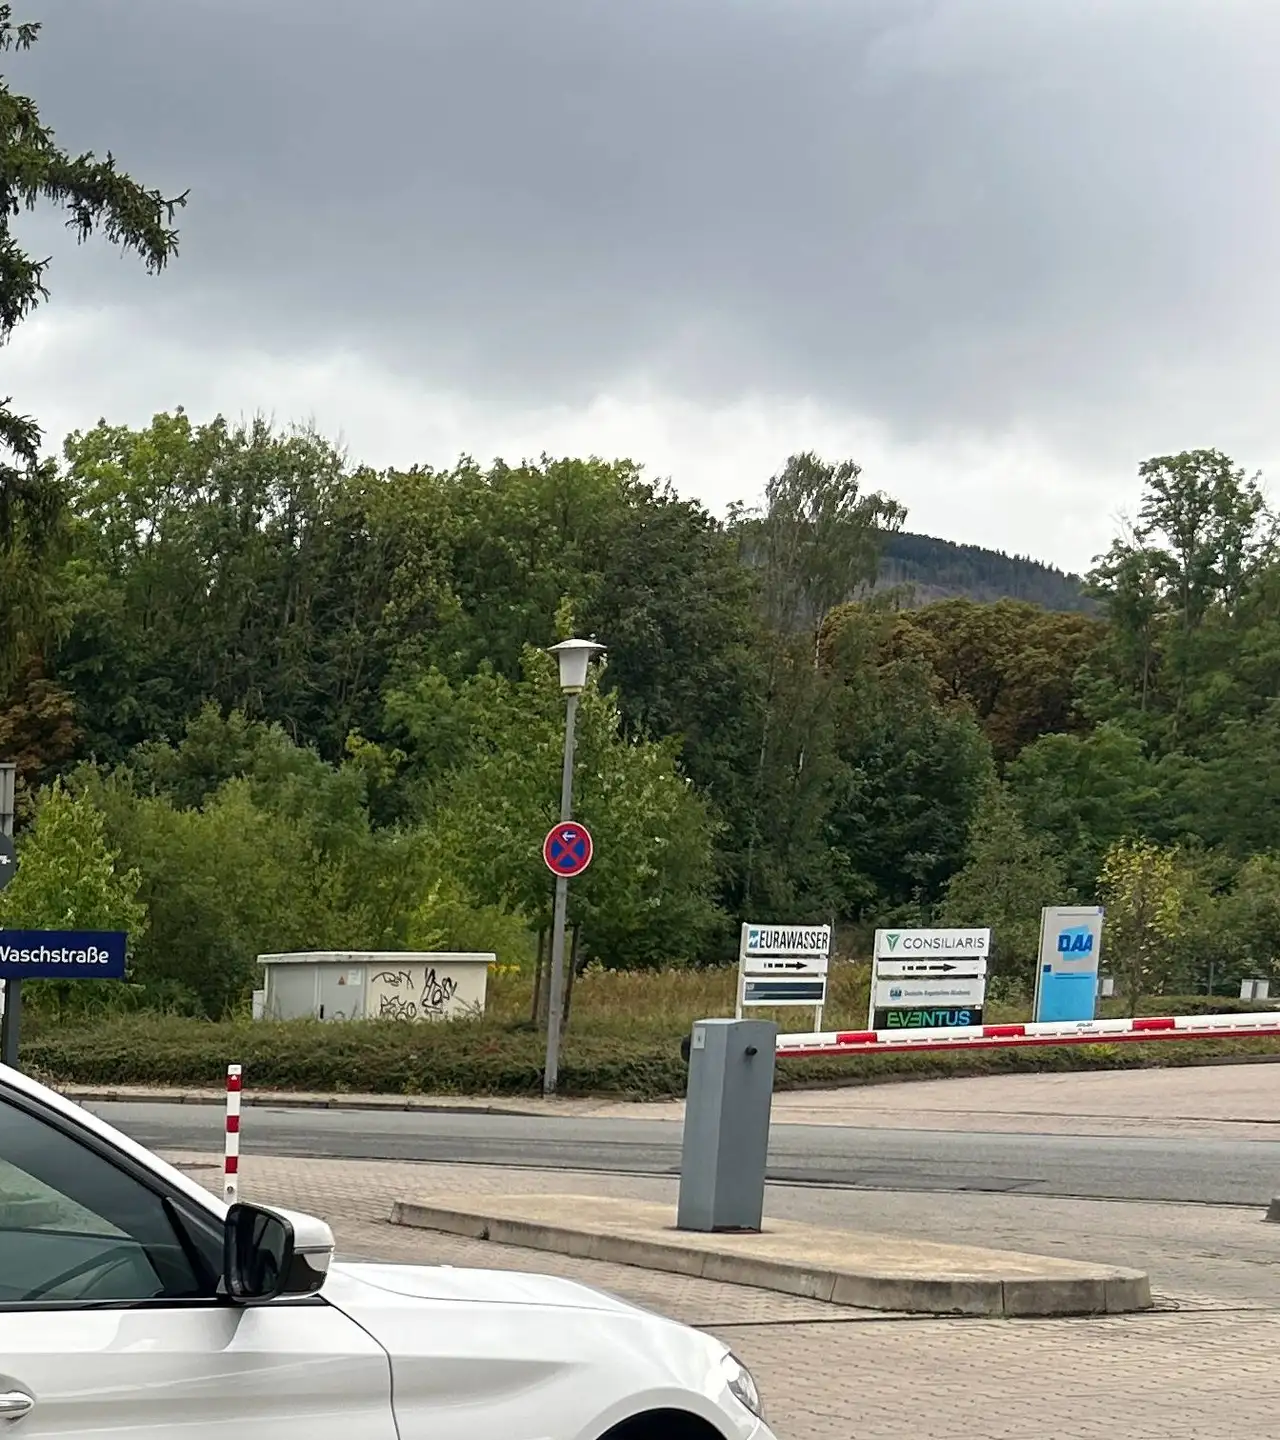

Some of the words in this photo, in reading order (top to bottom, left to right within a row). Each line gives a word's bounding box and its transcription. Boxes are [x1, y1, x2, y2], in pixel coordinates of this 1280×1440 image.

[759, 930, 829, 949] EURAWASSER
[903, 937, 985, 949] CONSILIARIS
[1057, 934, 1094, 952] DAA
[886, 1010, 971, 1028] EVENTUS
